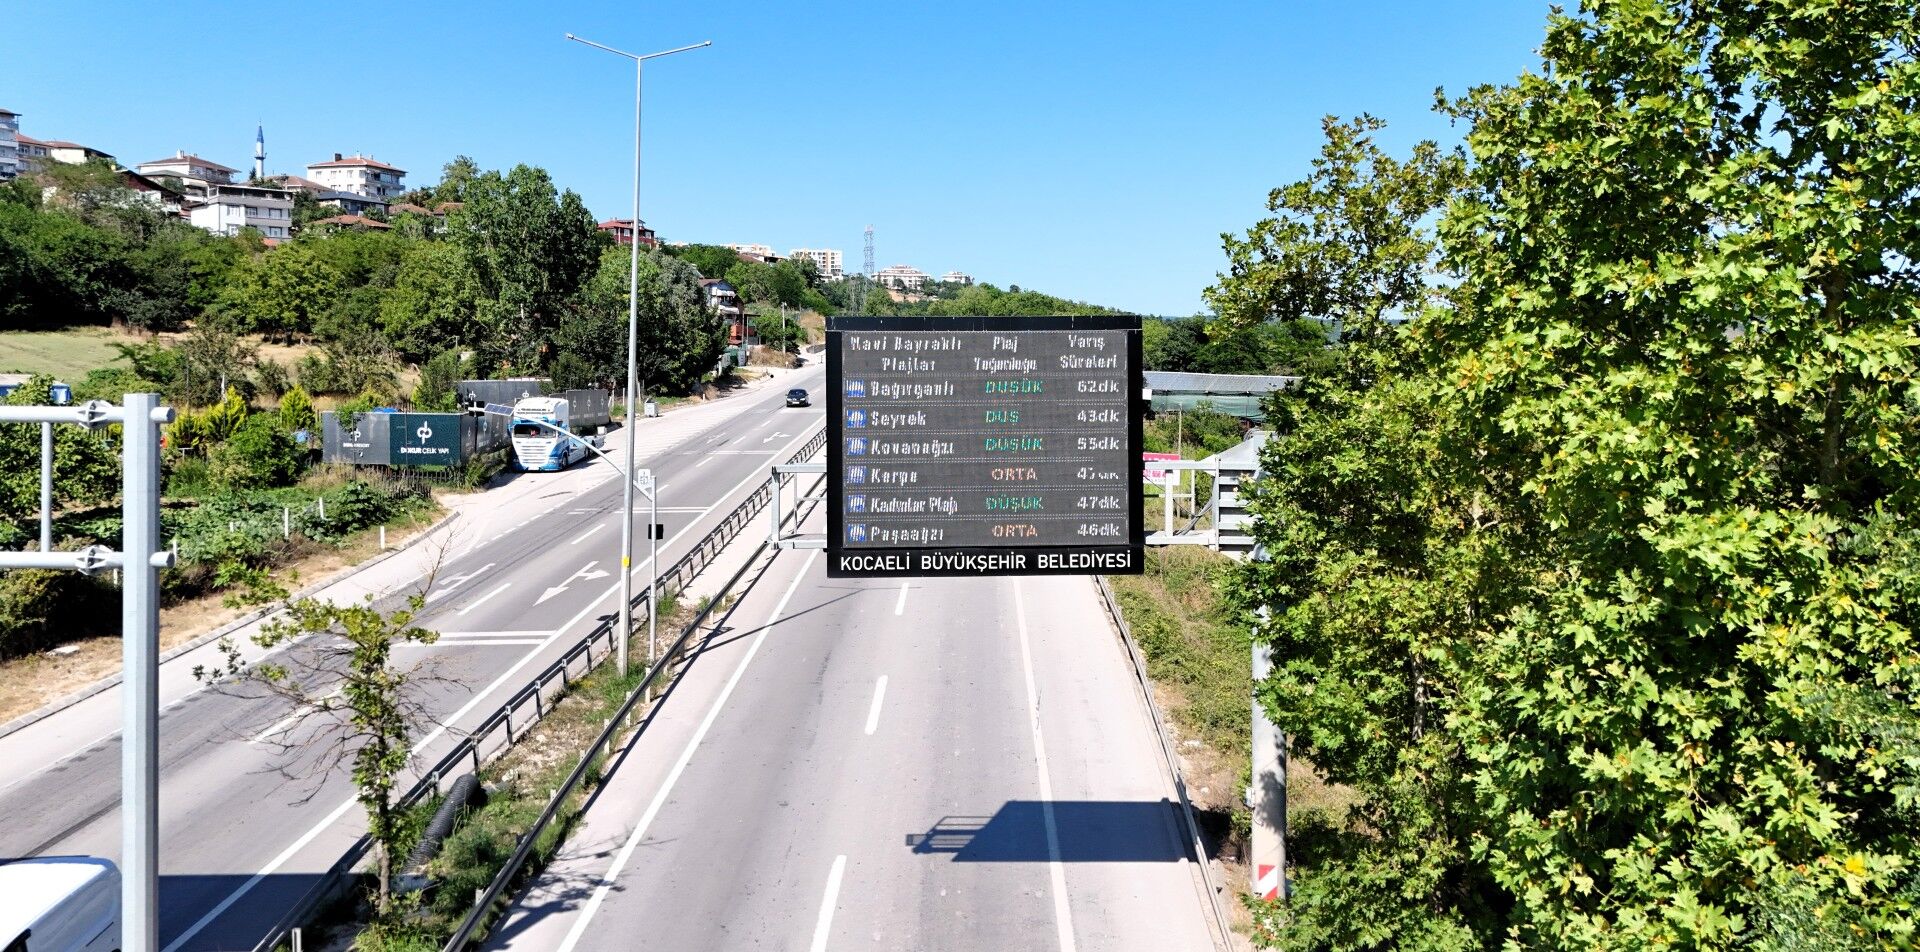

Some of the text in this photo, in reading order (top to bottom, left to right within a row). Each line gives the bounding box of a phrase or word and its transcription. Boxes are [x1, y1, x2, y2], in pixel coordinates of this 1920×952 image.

[871, 410, 926, 429] Seyrek
[1077, 437, 1119, 450] 55dk
[991, 467, 1037, 480] ORTA
[1077, 496, 1121, 509] 47dk
[991, 524, 1037, 537] ORTA
[1077, 523, 1121, 537] 46dk
[840, 550, 1131, 572] KOCAELİ BÜYÜKŞEHİR BELEDİYESİ
